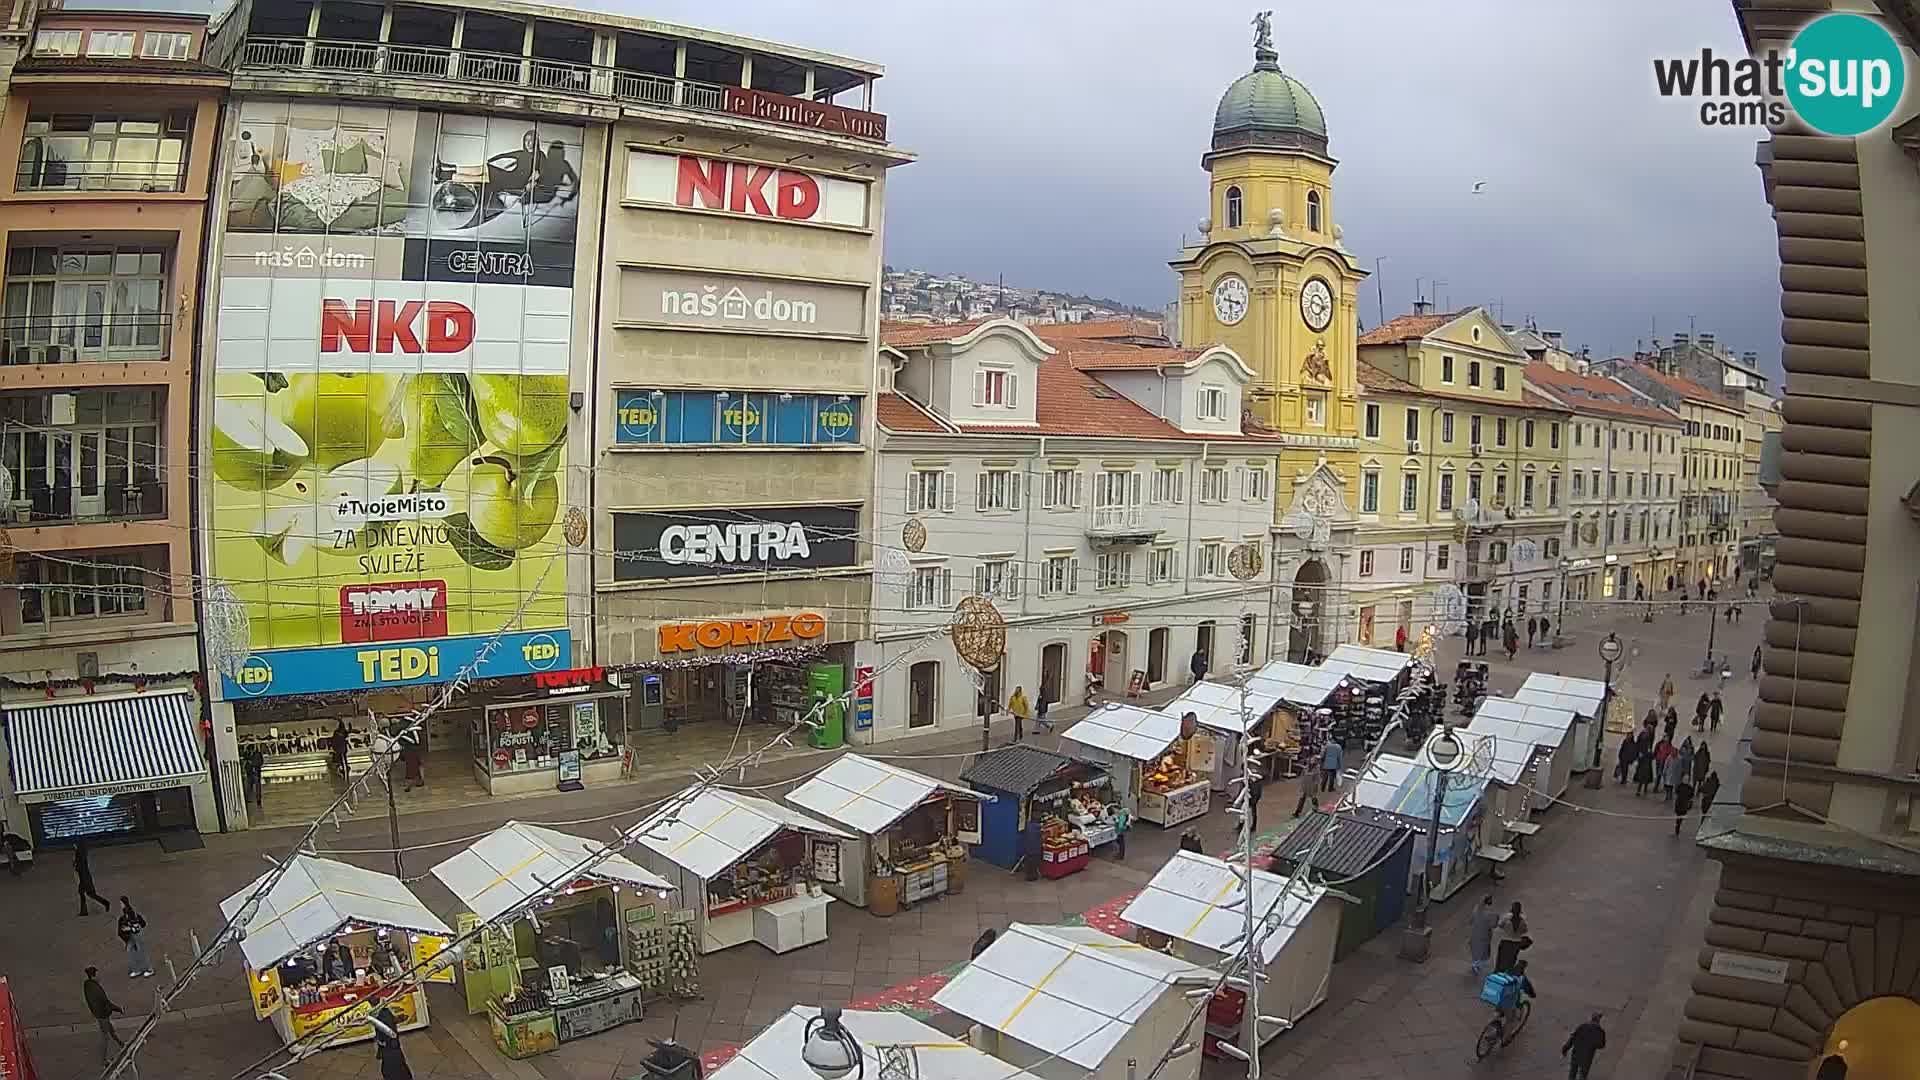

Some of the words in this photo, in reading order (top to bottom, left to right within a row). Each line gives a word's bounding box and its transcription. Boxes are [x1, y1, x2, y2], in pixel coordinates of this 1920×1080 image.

[676, 155, 820, 220] NKD
[319, 246, 365, 268] dom
[447, 249, 535, 276] CENTRA
[661, 285, 717, 315] naš
[754, 290, 816, 323] dom
[320, 297, 477, 354] NKD
[618, 408, 657, 425] TEDi
[723, 410, 760, 427] TEDi
[820, 411, 854, 428] TEDi
[338, 497, 446, 517] #TvojeMisto
[333, 529, 357, 549] ZA
[366, 525, 451, 548] DNEVNO
[659, 521, 810, 565] CENTRA
[359, 547, 425, 576] SVJEŽE
[348, 588, 438, 615] TOMMY
[659, 613, 825, 654] KORZO
[357, 646, 440, 683] TEDi
[521, 643, 560, 661] TEDi
